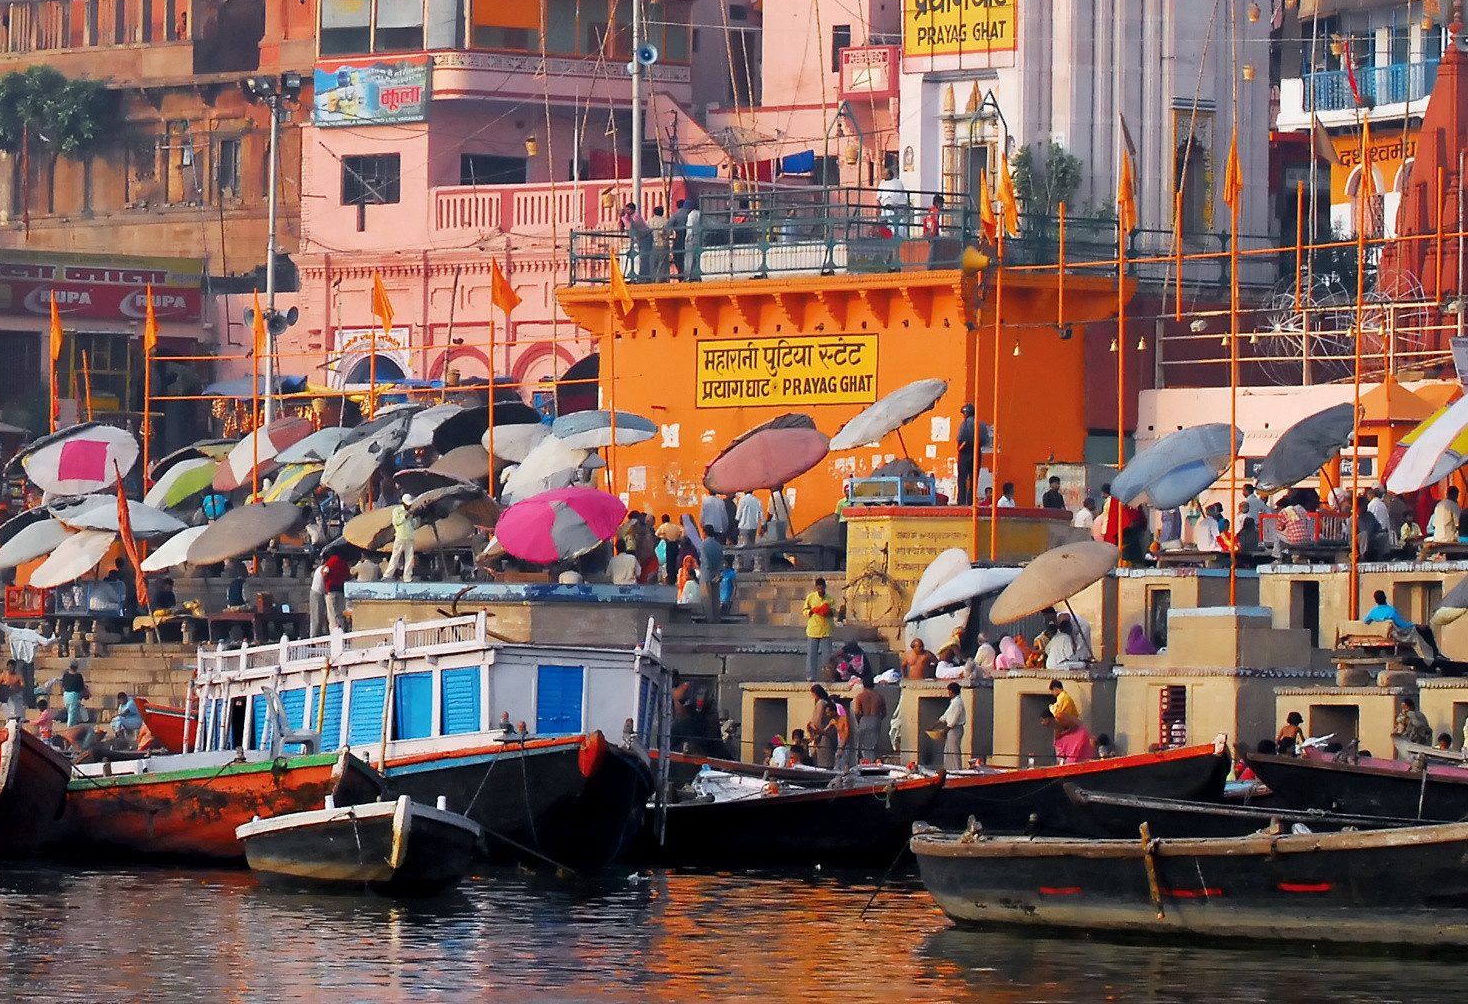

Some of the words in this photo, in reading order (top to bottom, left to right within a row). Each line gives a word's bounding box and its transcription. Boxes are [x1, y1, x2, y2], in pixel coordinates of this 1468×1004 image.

[918, 24, 967, 46] PRAYAG
[973, 21, 1006, 41] GHAT
[381, 86, 420, 111] झूला
[1340, 137, 1416, 167] दशश्वमेध
[40, 290, 92, 305] RUPA
[135, 295, 186, 308] RUPA
[703, 342, 760, 375] महारानी
[763, 340, 814, 377] पुटिया
[818, 338, 865, 370] स्टेट
[702, 379, 744, 400] प्रयाग
[746, 378, 770, 397] घाट
[783, 376, 837, 396] PRAYAG
[840, 375, 873, 392] GHAT
